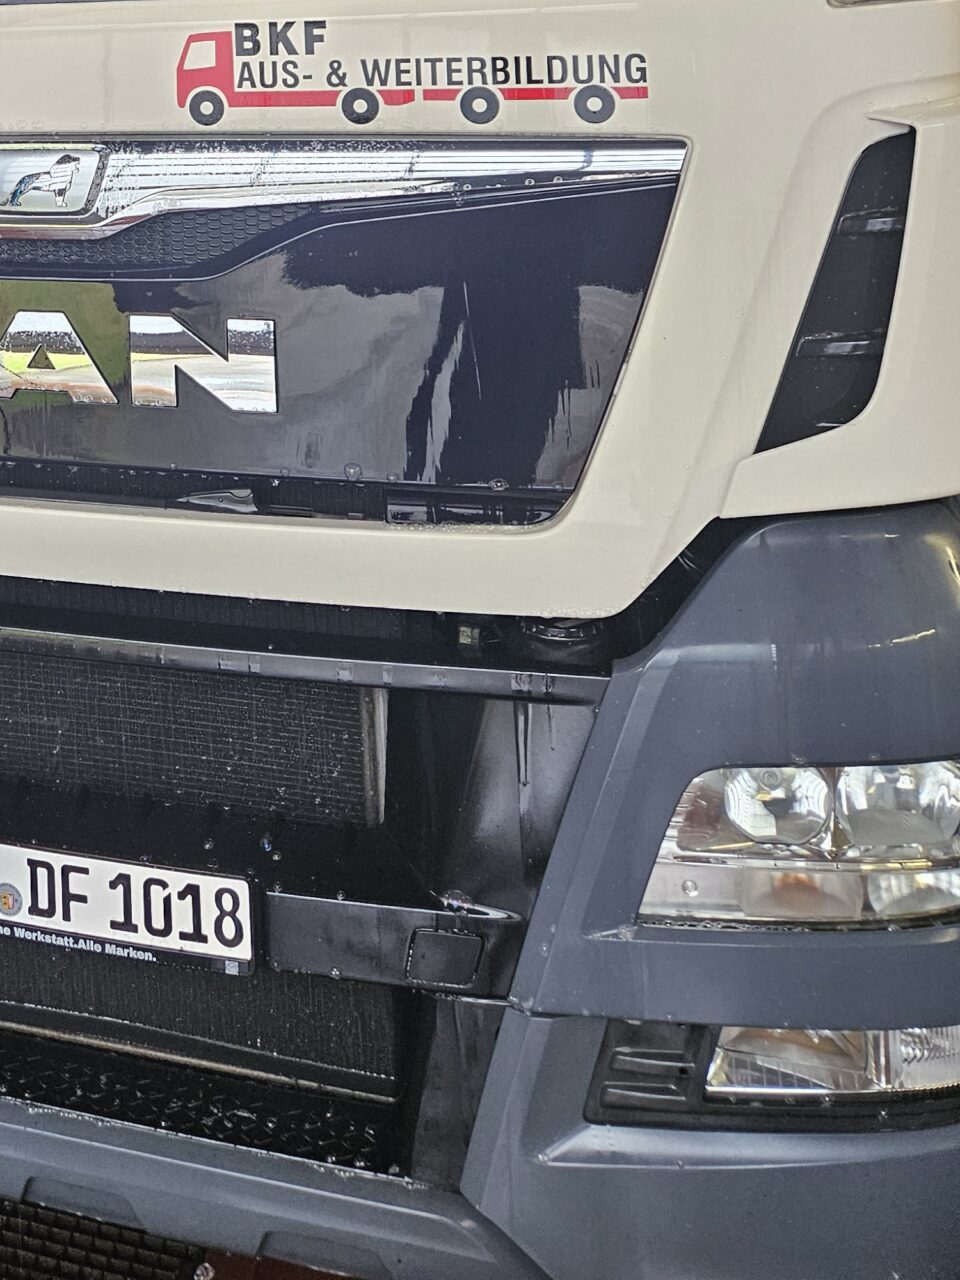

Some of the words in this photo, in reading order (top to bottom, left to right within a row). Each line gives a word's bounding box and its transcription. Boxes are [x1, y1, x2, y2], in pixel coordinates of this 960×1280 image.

[234, 20, 327, 56] BKF
[237, 60, 313, 89] AUS-
[326, 60, 348, 87] &
[360, 53, 648, 87] WEITERBILDUNG
[26, 858, 90, 923] DF
[109, 873, 244, 948] 1018
[105, 943, 158, 962] Marken.
